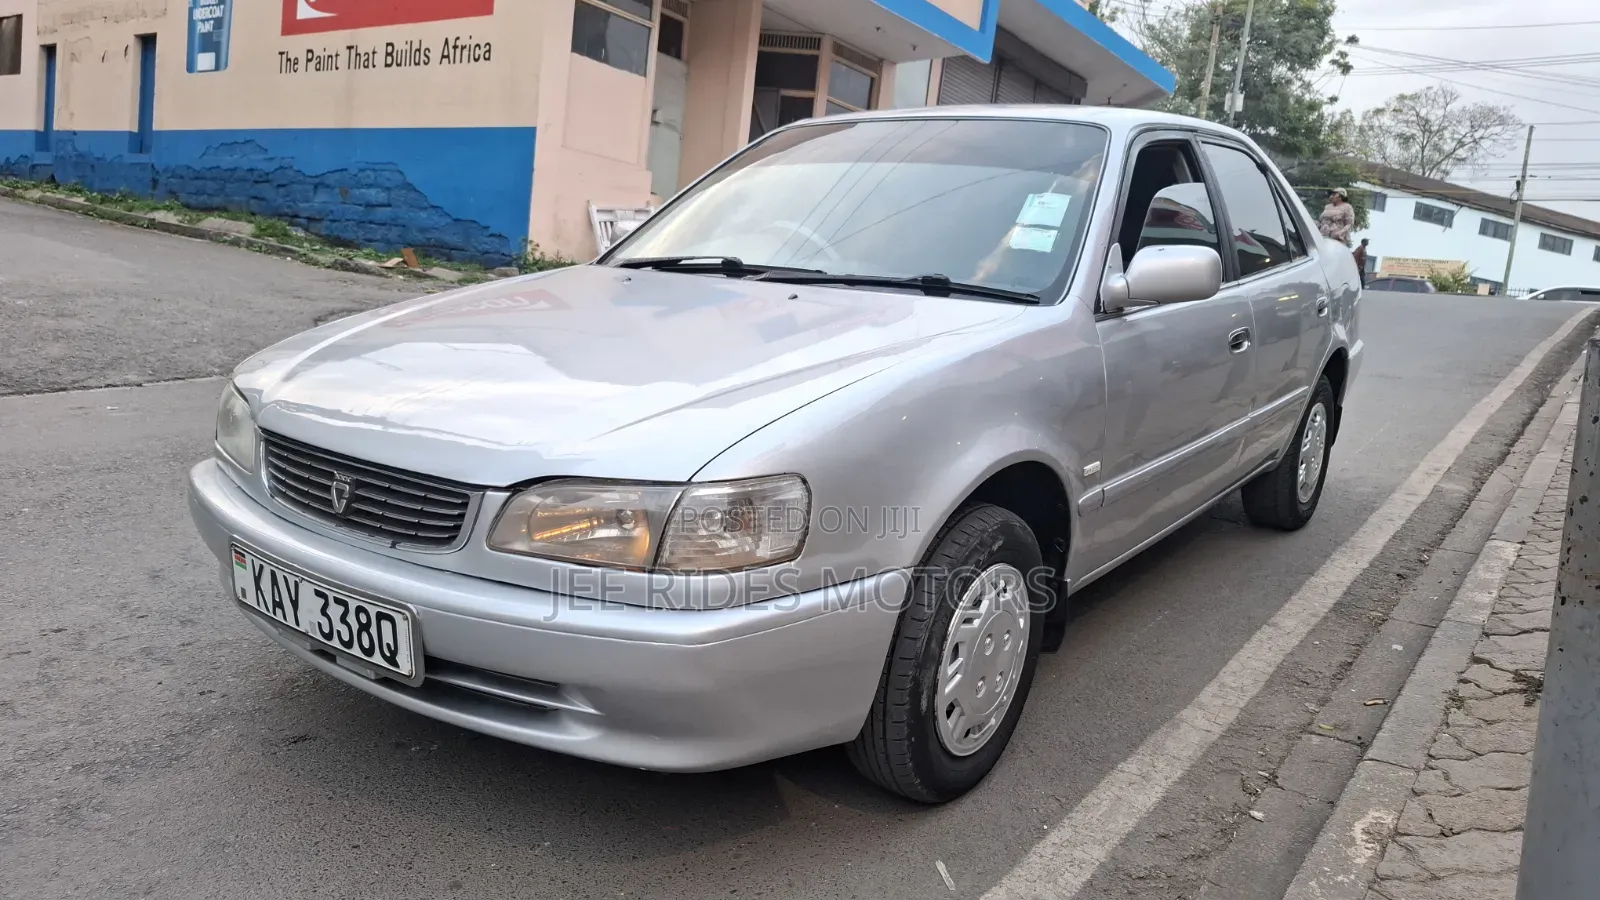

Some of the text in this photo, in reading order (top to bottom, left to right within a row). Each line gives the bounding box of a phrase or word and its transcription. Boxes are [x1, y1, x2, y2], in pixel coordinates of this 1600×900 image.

[197, 20, 214, 33] PAINT
[278, 36, 492, 74] The Paint That Builds Africa
[251, 557, 300, 628] KAY
[313, 587, 401, 669] 338Q
